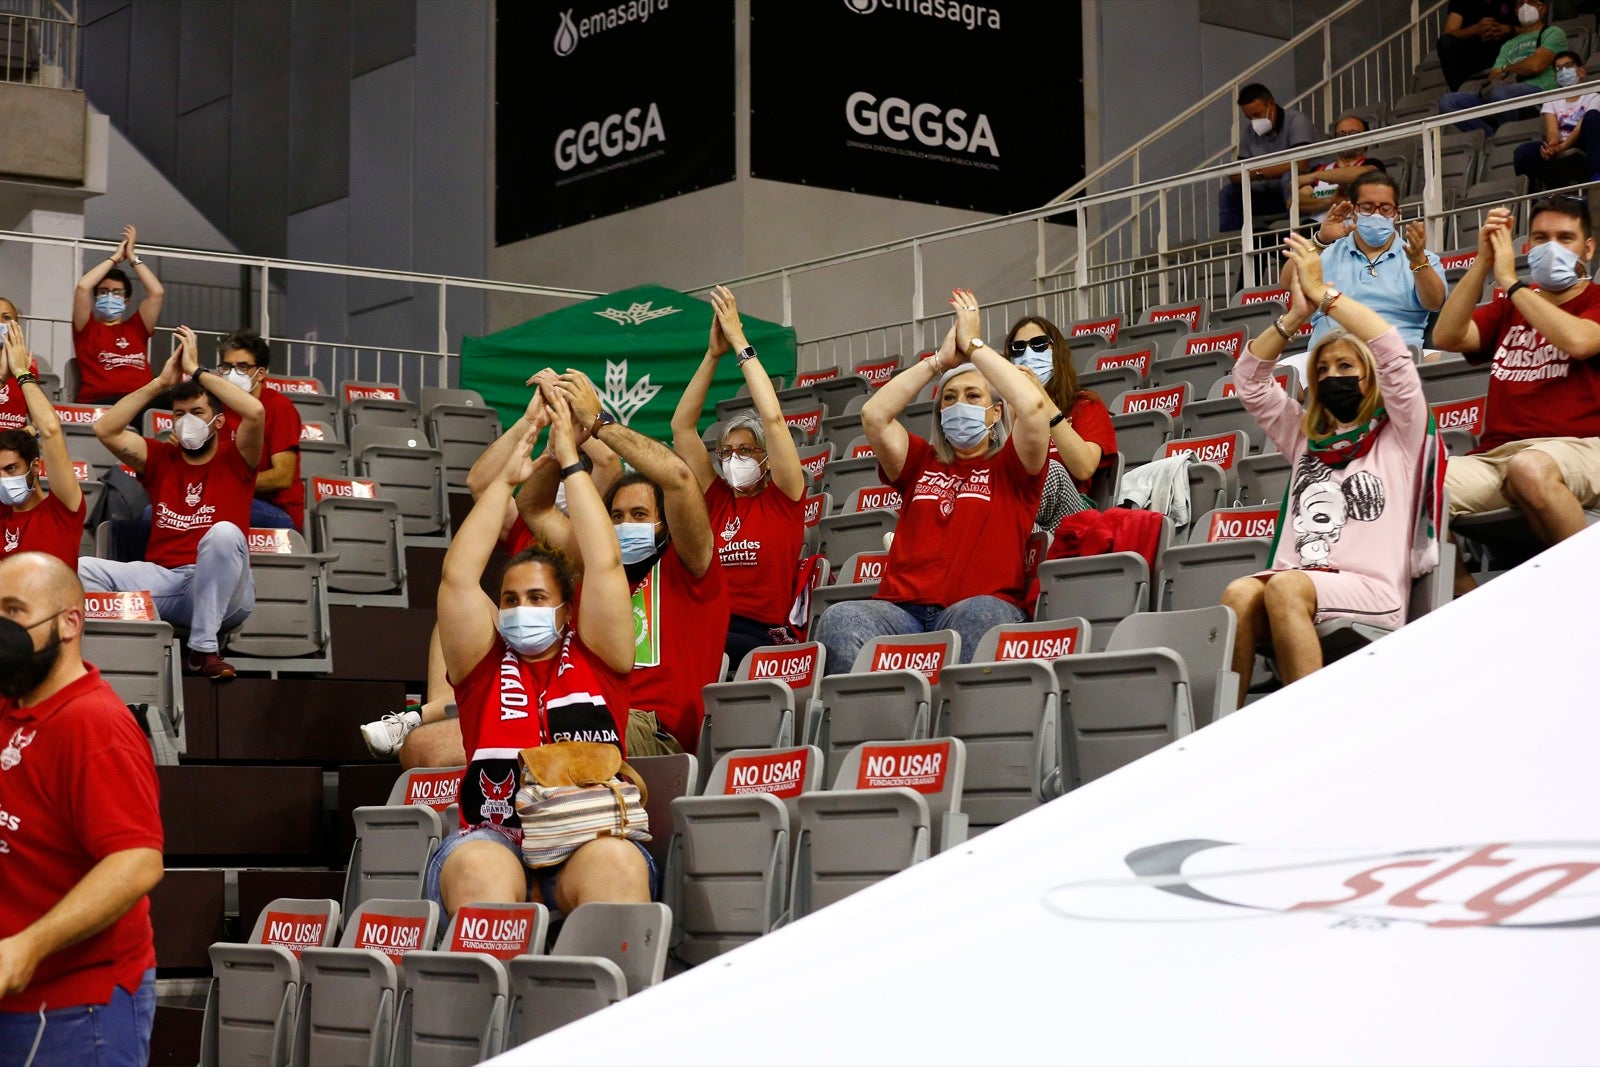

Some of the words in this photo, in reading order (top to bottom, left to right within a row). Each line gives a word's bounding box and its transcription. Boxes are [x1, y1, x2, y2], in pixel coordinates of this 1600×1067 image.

[1128, 399, 1148, 413] NO
[1150, 393, 1180, 410] USAR
[156, 417, 173, 429] NO
[1438, 406, 1479, 428] USAR
[1197, 442, 1229, 460] USAR
[317, 482, 334, 495] NO
[861, 494, 881, 508] NO
[882, 491, 903, 506] USA
[1216, 519, 1242, 537] NO
[1245, 518, 1275, 537] USA
[859, 562, 882, 577] NO
[103, 597, 146, 612] USAR
[1002, 640, 1029, 659] NO
[1031, 637, 1071, 658] USAR
[755, 659, 779, 677] NO
[781, 654, 812, 676] USAR
[877, 652, 903, 670] NO
[904, 651, 941, 670] USAR
[553, 729, 619, 743] GRANADA
[732, 765, 759, 786] NO
[762, 759, 802, 784] USAR
[866, 755, 896, 777] NO
[899, 752, 942, 777] USAR
[411, 781, 432, 798] NO
[268, 920, 293, 942] NO
[294, 922, 322, 943] USAR
[362, 922, 388, 945] NO
[391, 925, 420, 947] USAR
[460, 917, 489, 940] NO
[492, 918, 528, 941] USAR
